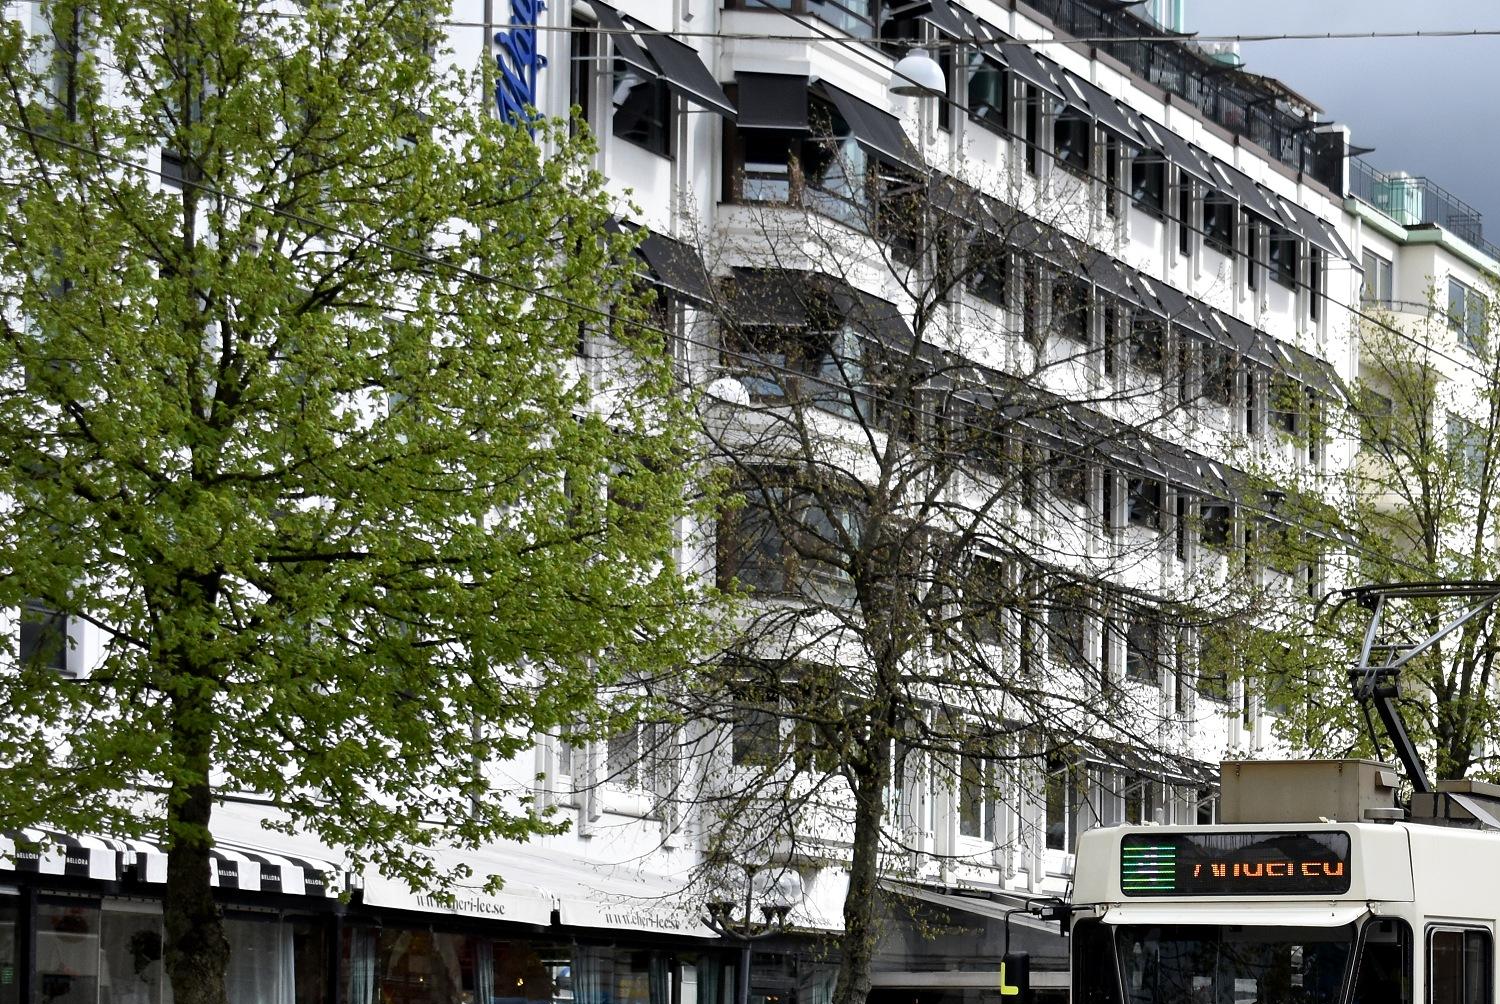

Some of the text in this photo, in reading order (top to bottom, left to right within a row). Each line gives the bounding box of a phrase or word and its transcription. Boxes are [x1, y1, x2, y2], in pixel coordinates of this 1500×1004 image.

[66, 857, 89, 866] BELLORA
[218, 869, 238, 877] BELLORA
[261, 873, 280, 881] BELLORA
[304, 878, 324, 886] BELLORA
